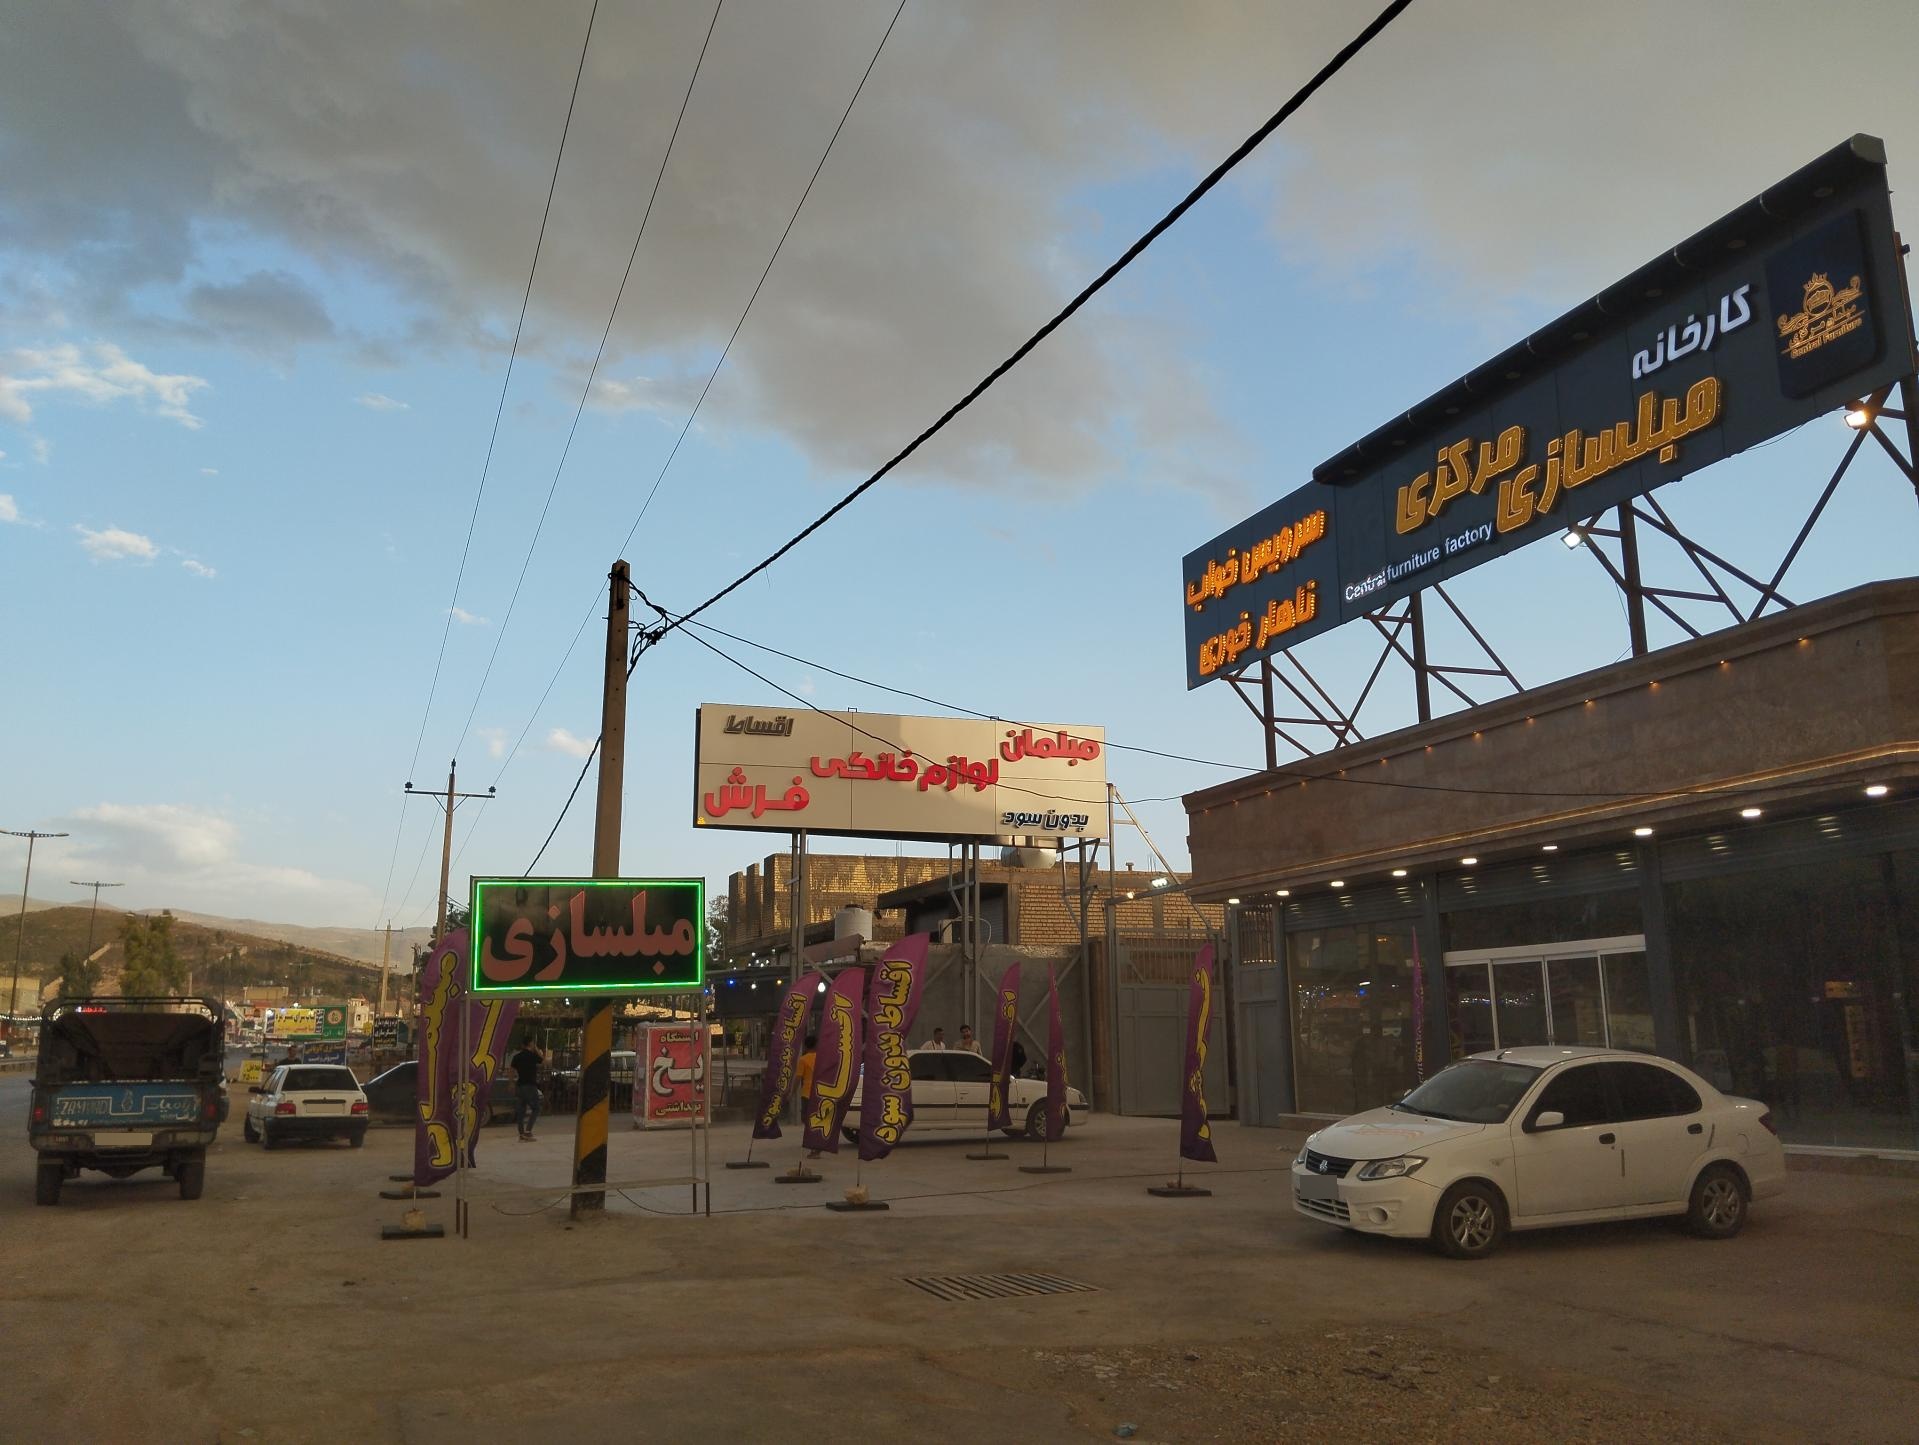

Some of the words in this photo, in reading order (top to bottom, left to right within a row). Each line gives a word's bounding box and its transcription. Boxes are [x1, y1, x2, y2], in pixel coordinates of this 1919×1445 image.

[1632, 283, 1752, 380] کارخانه
[1396, 425, 1524, 535] مرکزی
[1495, 376, 1722, 533] مبلسازی
[1239, 509, 1328, 584] سرویس
[1345, 568, 1386, 601] Central
[1387, 547, 1440, 580] furniture
[1445, 522, 1492, 554] factory
[1186, 547, 1239, 612] خواب
[1199, 611, 1252, 676] خوری
[1256, 579, 1319, 650] ناهار
[723, 714, 794, 736] اقساط
[1000, 729, 1100, 766] مبلمان
[704, 767, 810, 817] فرش
[918, 755, 999, 792] لوازم
[1000, 808, 1042, 826] سود
[1044, 809, 1089, 830] بدون
[481, 890, 695, 981] مبلسازی
[782, 993, 807, 1044] اقساط
[875, 960, 912, 1028] اقساط
[653, 1047, 704, 1094] یخ
[810, 992, 853, 1137] اقساط
[878, 1032, 911, 1090] بدون
[875, 1095, 908, 1144] سود
